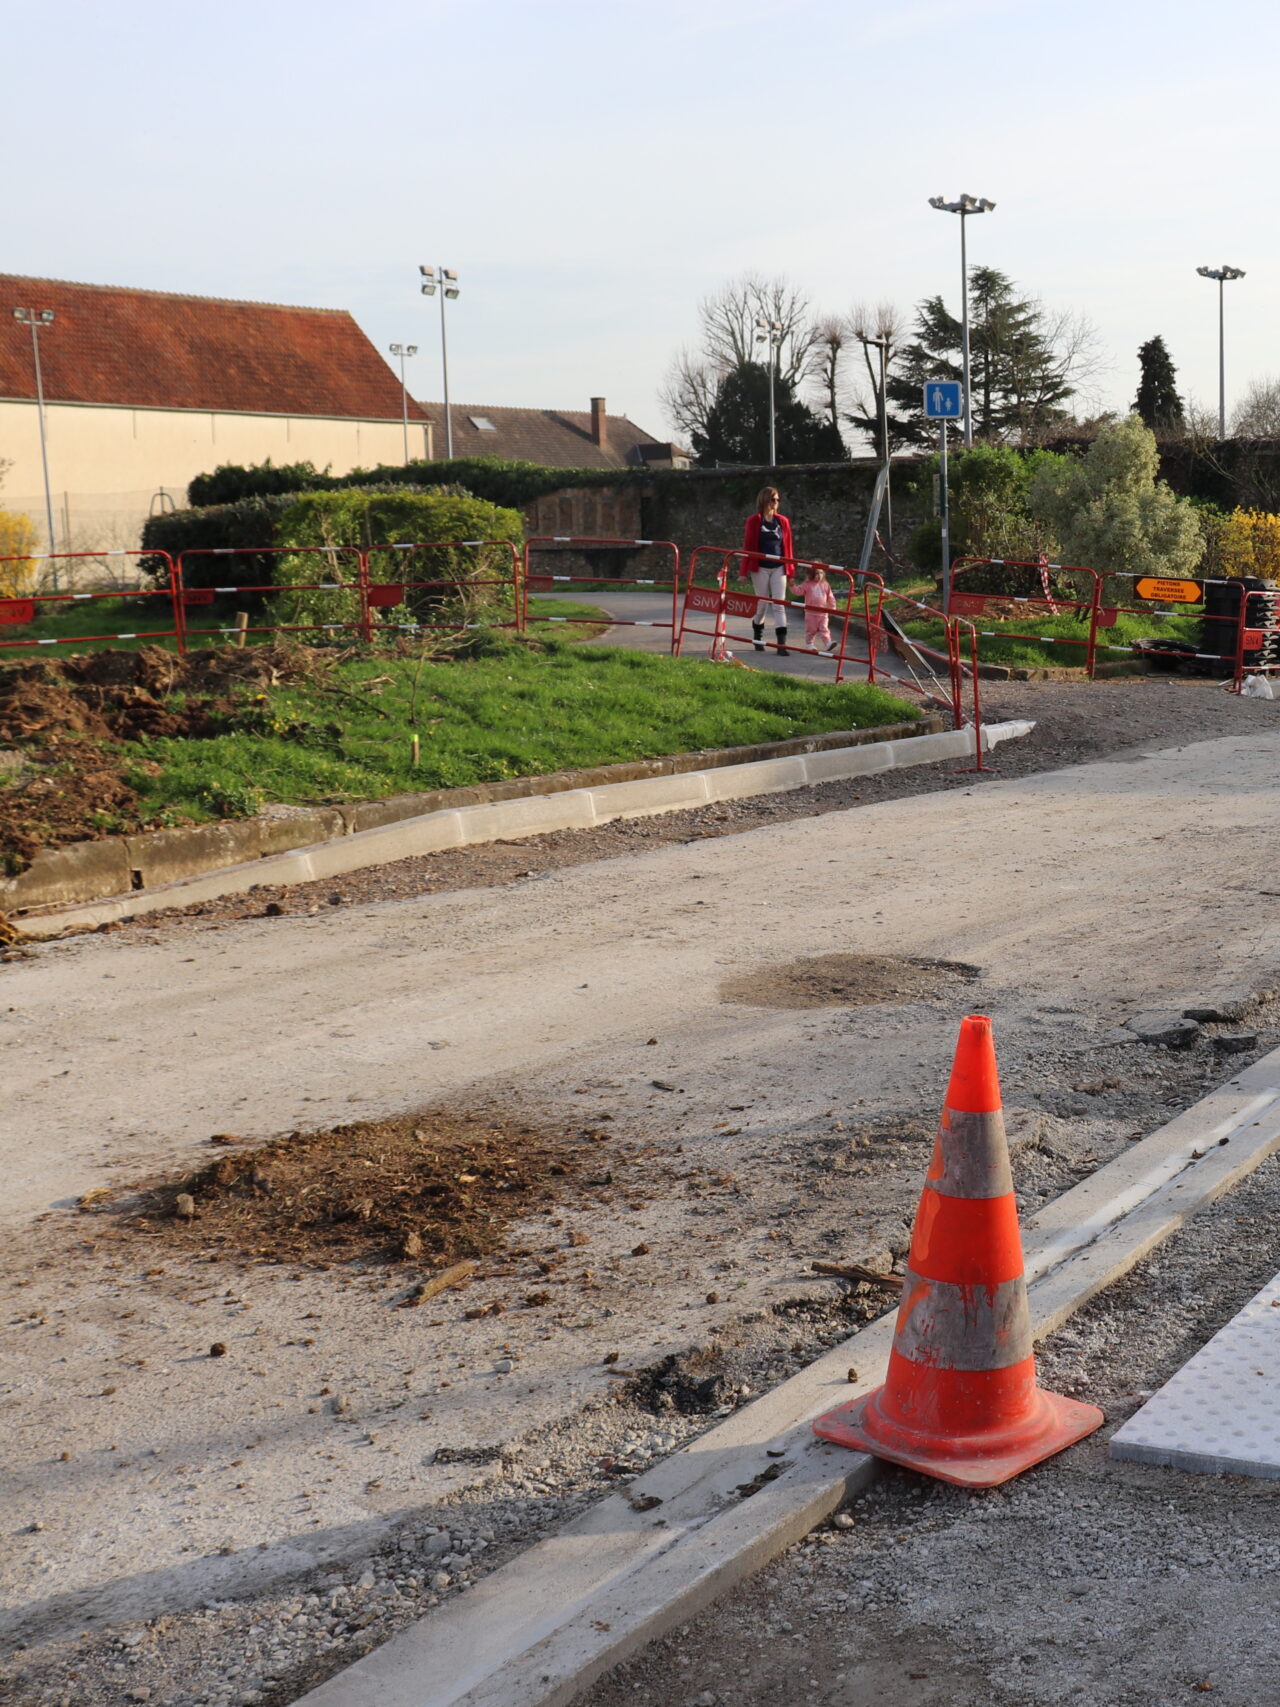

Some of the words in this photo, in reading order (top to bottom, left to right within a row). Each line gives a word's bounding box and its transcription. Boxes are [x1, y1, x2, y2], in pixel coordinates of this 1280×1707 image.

[1152, 586, 1184, 594] TRAVERSEE
[692, 595, 720, 609] SNV
[727, 600, 753, 613] SNV
